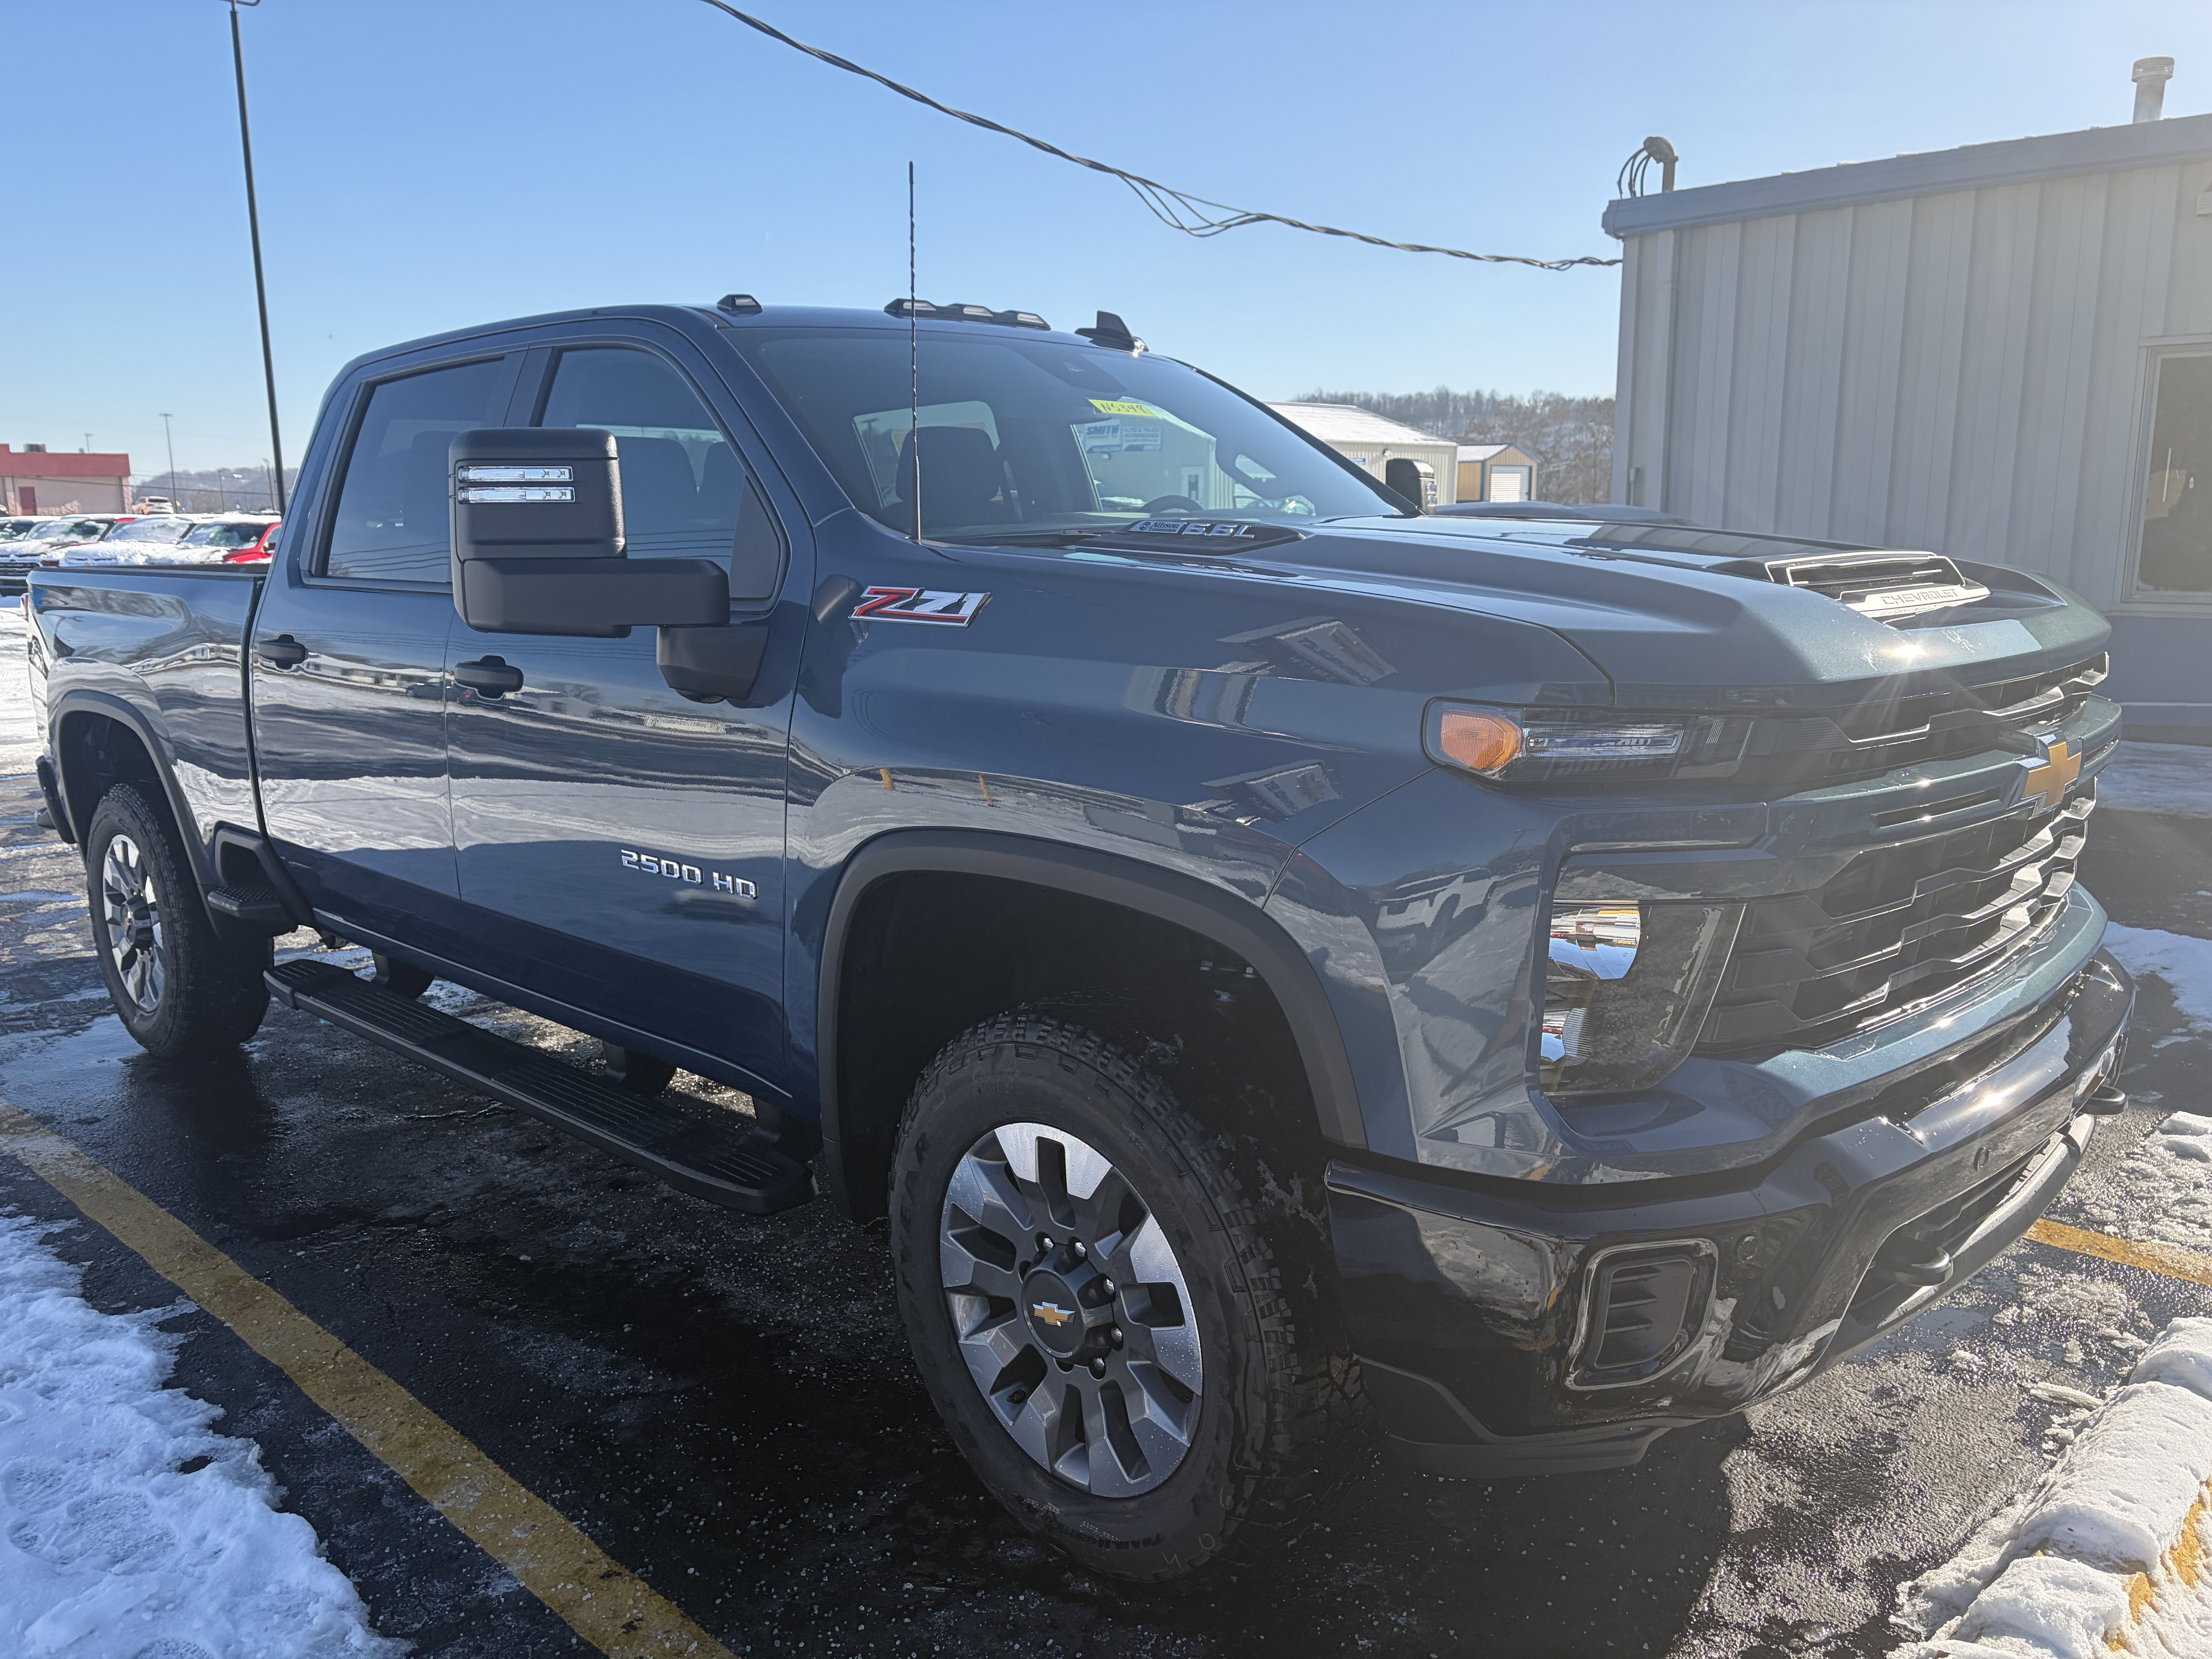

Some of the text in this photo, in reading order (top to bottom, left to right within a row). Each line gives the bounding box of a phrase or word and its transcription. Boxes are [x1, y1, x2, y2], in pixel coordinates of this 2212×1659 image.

[1087, 425, 1119, 435] SMITH
[848, 585, 991, 627] Z71
[1881, 589, 1958, 605] CHEVROLET
[621, 849, 759, 900] 2500 HD
